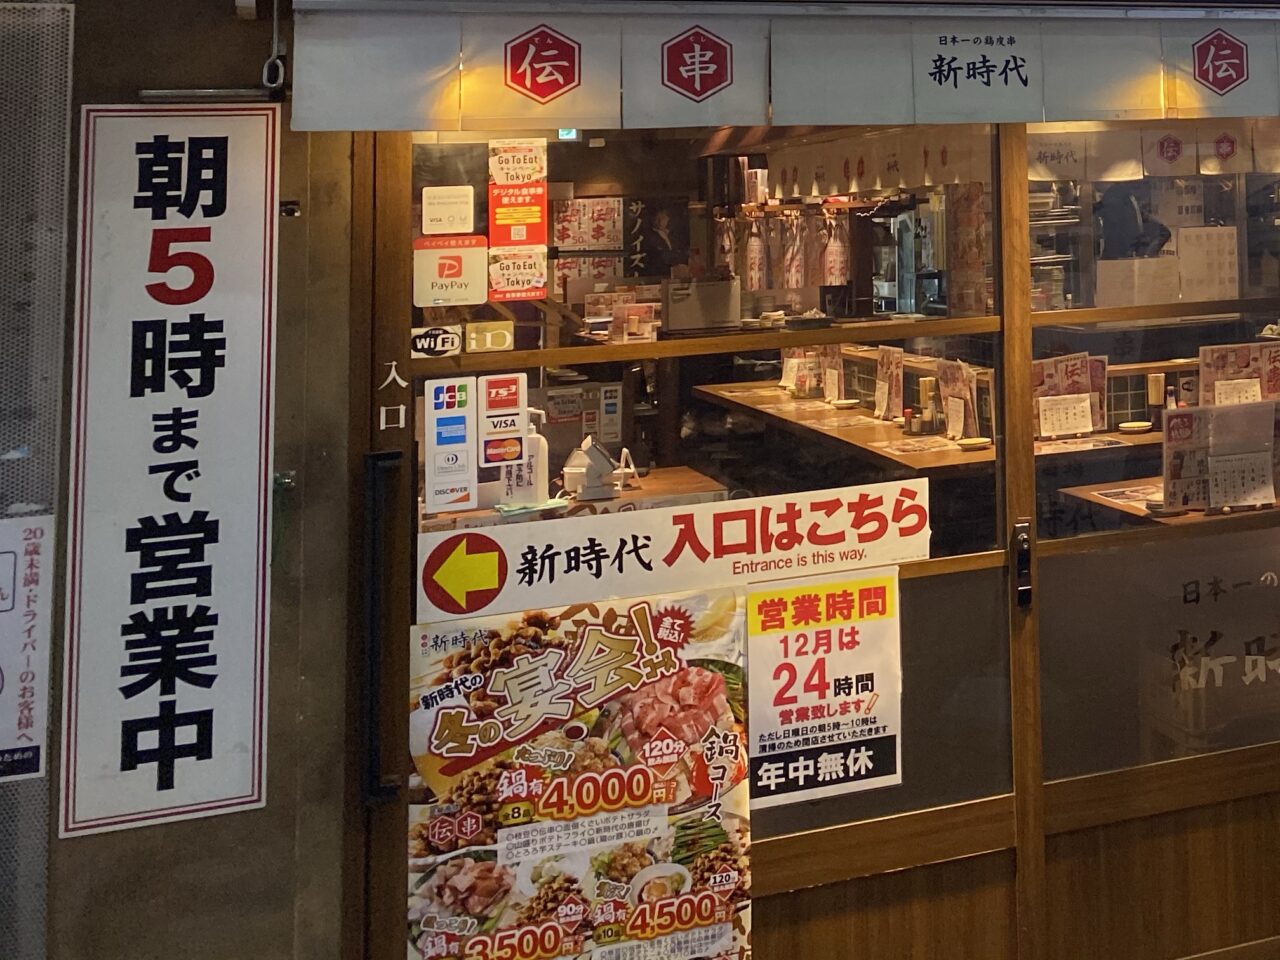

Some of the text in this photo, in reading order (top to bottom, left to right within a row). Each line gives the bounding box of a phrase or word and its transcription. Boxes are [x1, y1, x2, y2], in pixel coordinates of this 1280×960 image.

[516, 43, 570, 89] 伝
[679, 43, 717, 91] 串
[928, 53, 1029, 89] 新時代
[1202, 45, 1241, 82] 伝
[497, 155, 511, 166] Go
[523, 154, 539, 164] Eat
[505, 171, 532, 182] Tokyo
[431, 280, 470, 292] PayPay
[505, 277, 532, 289] Tokyo
[469, 330, 512, 351] iD
[378, 360, 409, 431] 入口
[491, 419, 516, 430] VISA
[118, 133, 229, 792] 朝5時まで営業中
[434, 486, 468, 496] DISCOVER
[516, 487, 929, 587] 新時代 入口はこちら
[732, 548, 868, 576] Entrance is this way.
[757, 585, 887, 632] 営業時間
[430, 629, 490, 653] 新時代
[779, 626, 861, 659] 12月は
[420, 674, 483, 710] 新時代の
[772, 657, 876, 708] 24時間
[701, 725, 741, 822] 鍋コース
[757, 746, 875, 791] 年中無休
[433, 817, 476, 840] 伝 串
